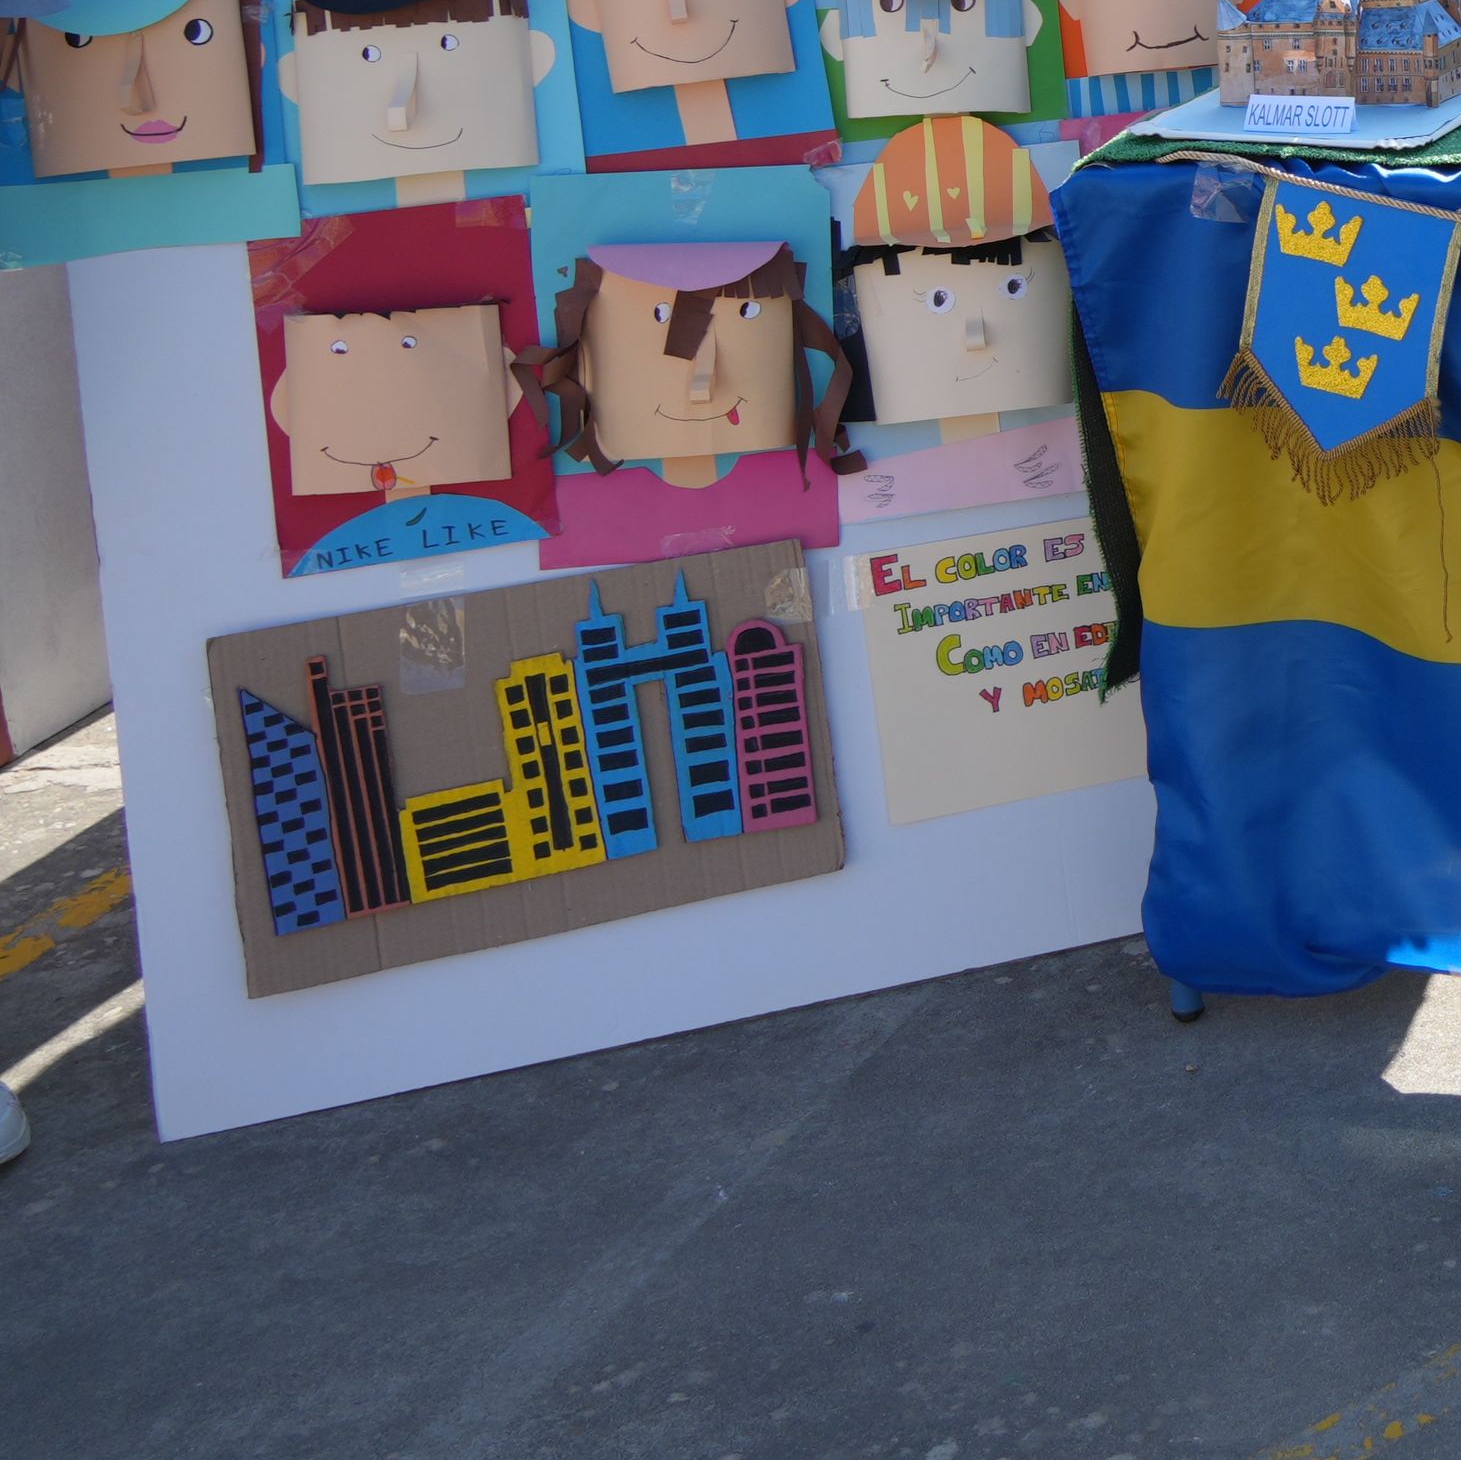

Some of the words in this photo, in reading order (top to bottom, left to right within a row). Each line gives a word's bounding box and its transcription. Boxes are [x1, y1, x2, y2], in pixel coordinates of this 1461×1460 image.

[1249, 103, 1304, 127] KALMAR
[1306, 105, 1350, 128] SLOTT
[316, 537, 394, 569] NIKE
[421, 517, 511, 550] LIKE
[935, 544, 1028, 584] COLOR
[1043, 533, 1086, 563] ES
[894, 583, 1070, 635] IMPORTANTE
[1077, 571, 1111, 597] EN
[936, 634, 1024, 676] COMO
[1031, 630, 1070, 659] EN
[978, 686, 1002, 713] Y
